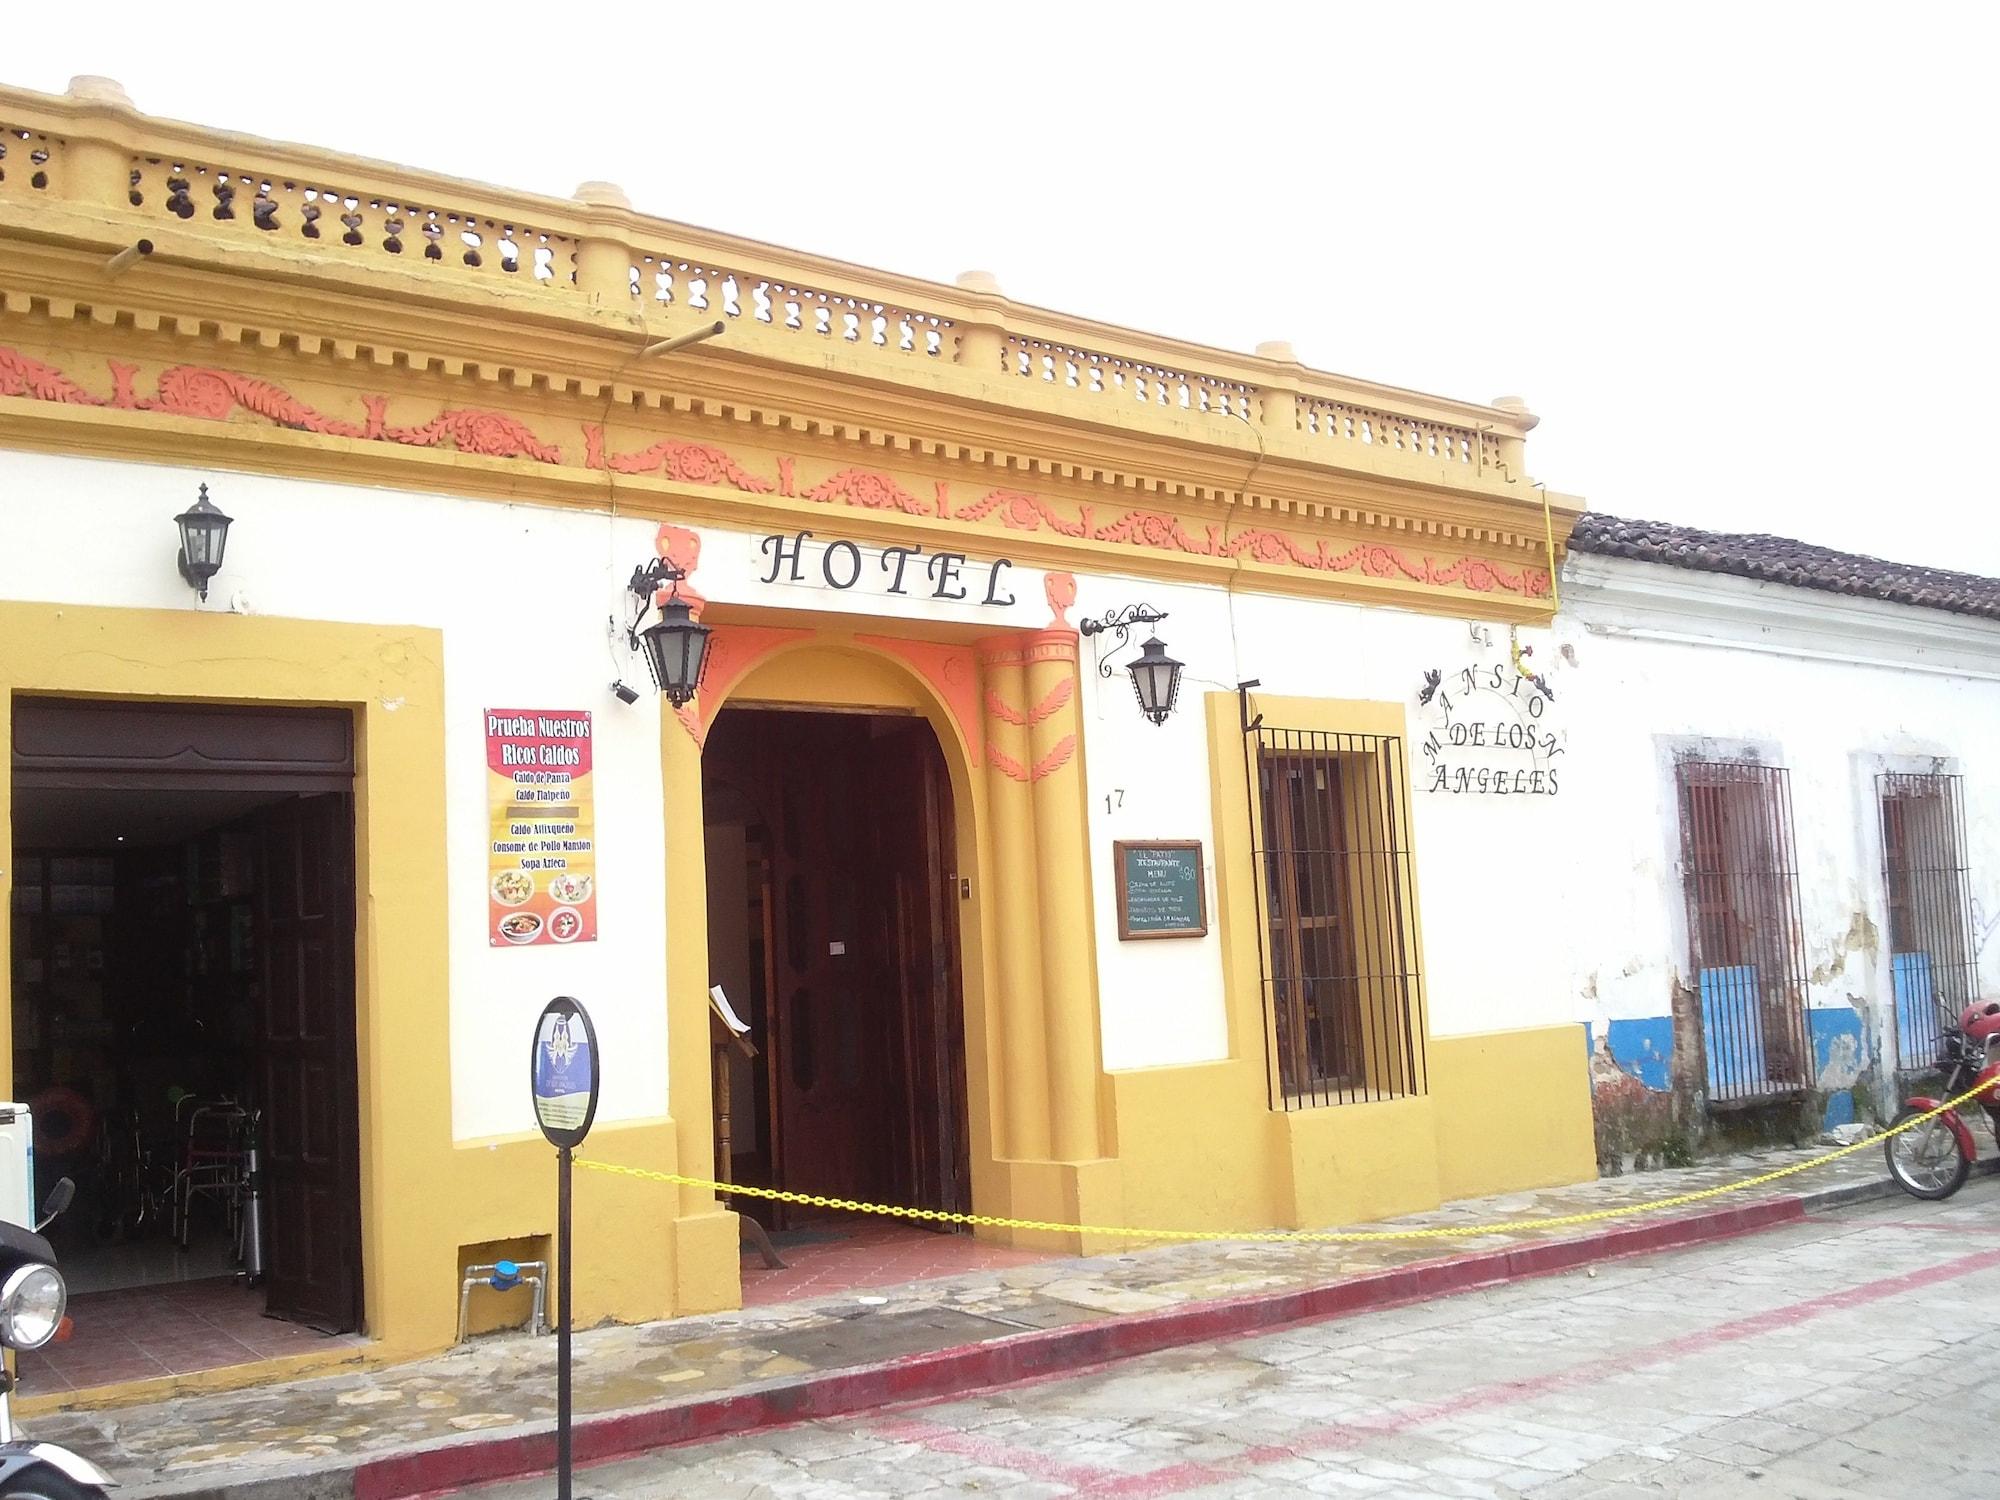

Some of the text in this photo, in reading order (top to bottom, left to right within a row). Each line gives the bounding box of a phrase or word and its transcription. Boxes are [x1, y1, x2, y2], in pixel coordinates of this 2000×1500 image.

[761, 530, 1016, 606] HOTEL
[487, 715, 590, 738] Prueba Nuestros
[1423, 664, 1565, 766] MANSION
[1450, 722, 1536, 749] DE LOS
[501, 743, 580, 766] Ricos Caldos
[514, 772, 534, 784] Caldo
[535, 773, 545, 783] de
[1429, 764, 1558, 796] ANGELES
[516, 789, 535, 801] Caldo
[1105, 789, 1125, 815] 17
[510, 824, 532, 836] Caldo
[528, 842, 539, 853] de
[540, 841, 561, 852] Pollo
[521, 857, 566, 870] Sopa Azteca
[1147, 869, 1167, 878] MENU
